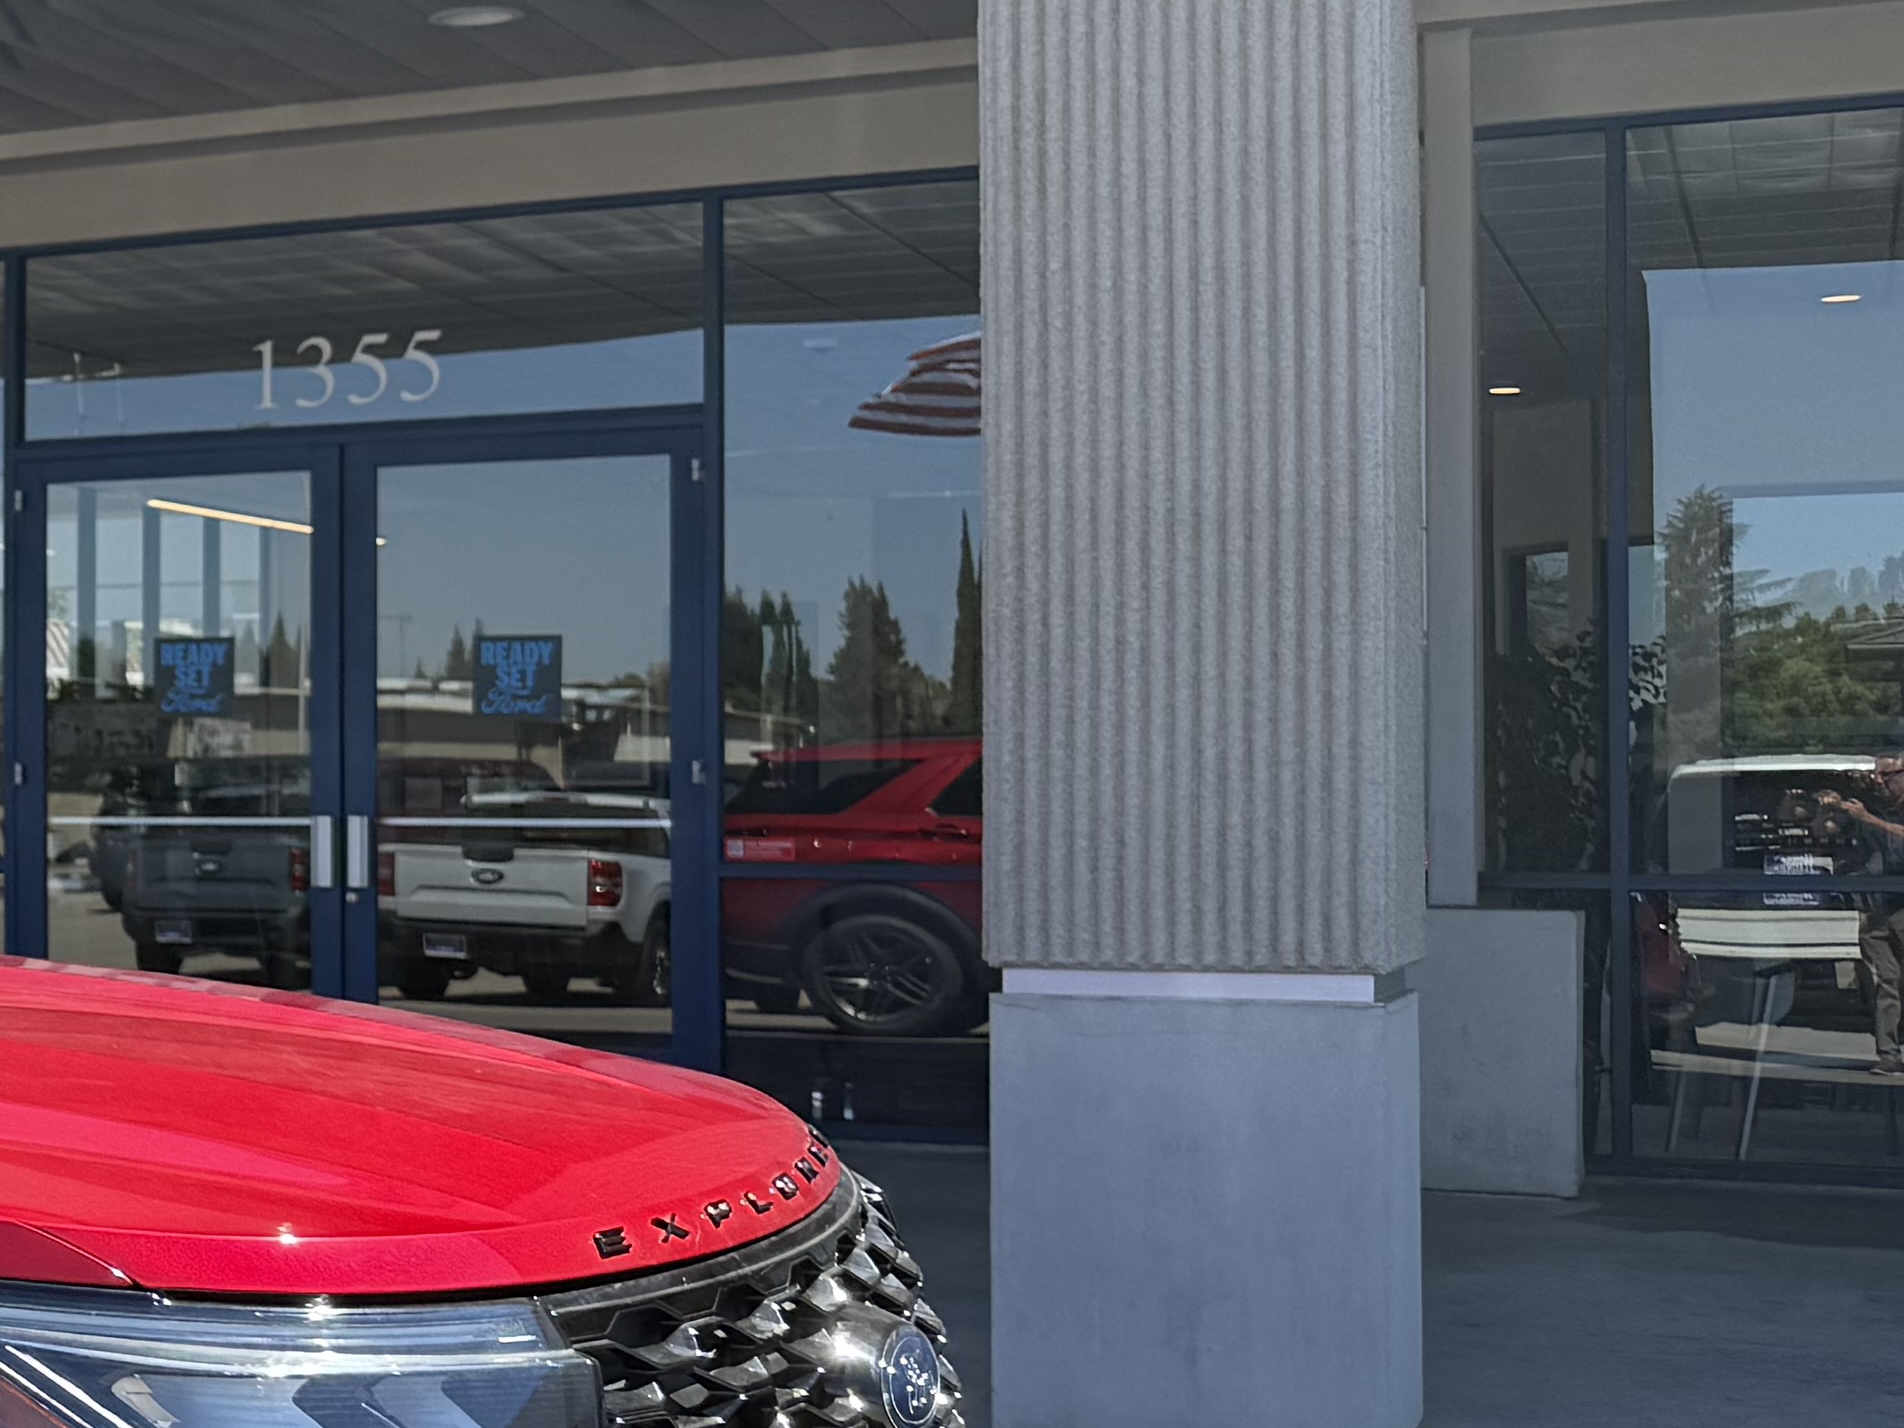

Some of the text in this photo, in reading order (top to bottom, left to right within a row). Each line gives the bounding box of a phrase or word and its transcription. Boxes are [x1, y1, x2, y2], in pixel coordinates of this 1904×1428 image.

[251, 329, 442, 410] 1355
[159, 642, 226, 667] READY
[479, 641, 553, 666] READY
[174, 665, 212, 688] SET
[495, 666, 536, 690] SET
[480, 688, 546, 715] Ford
